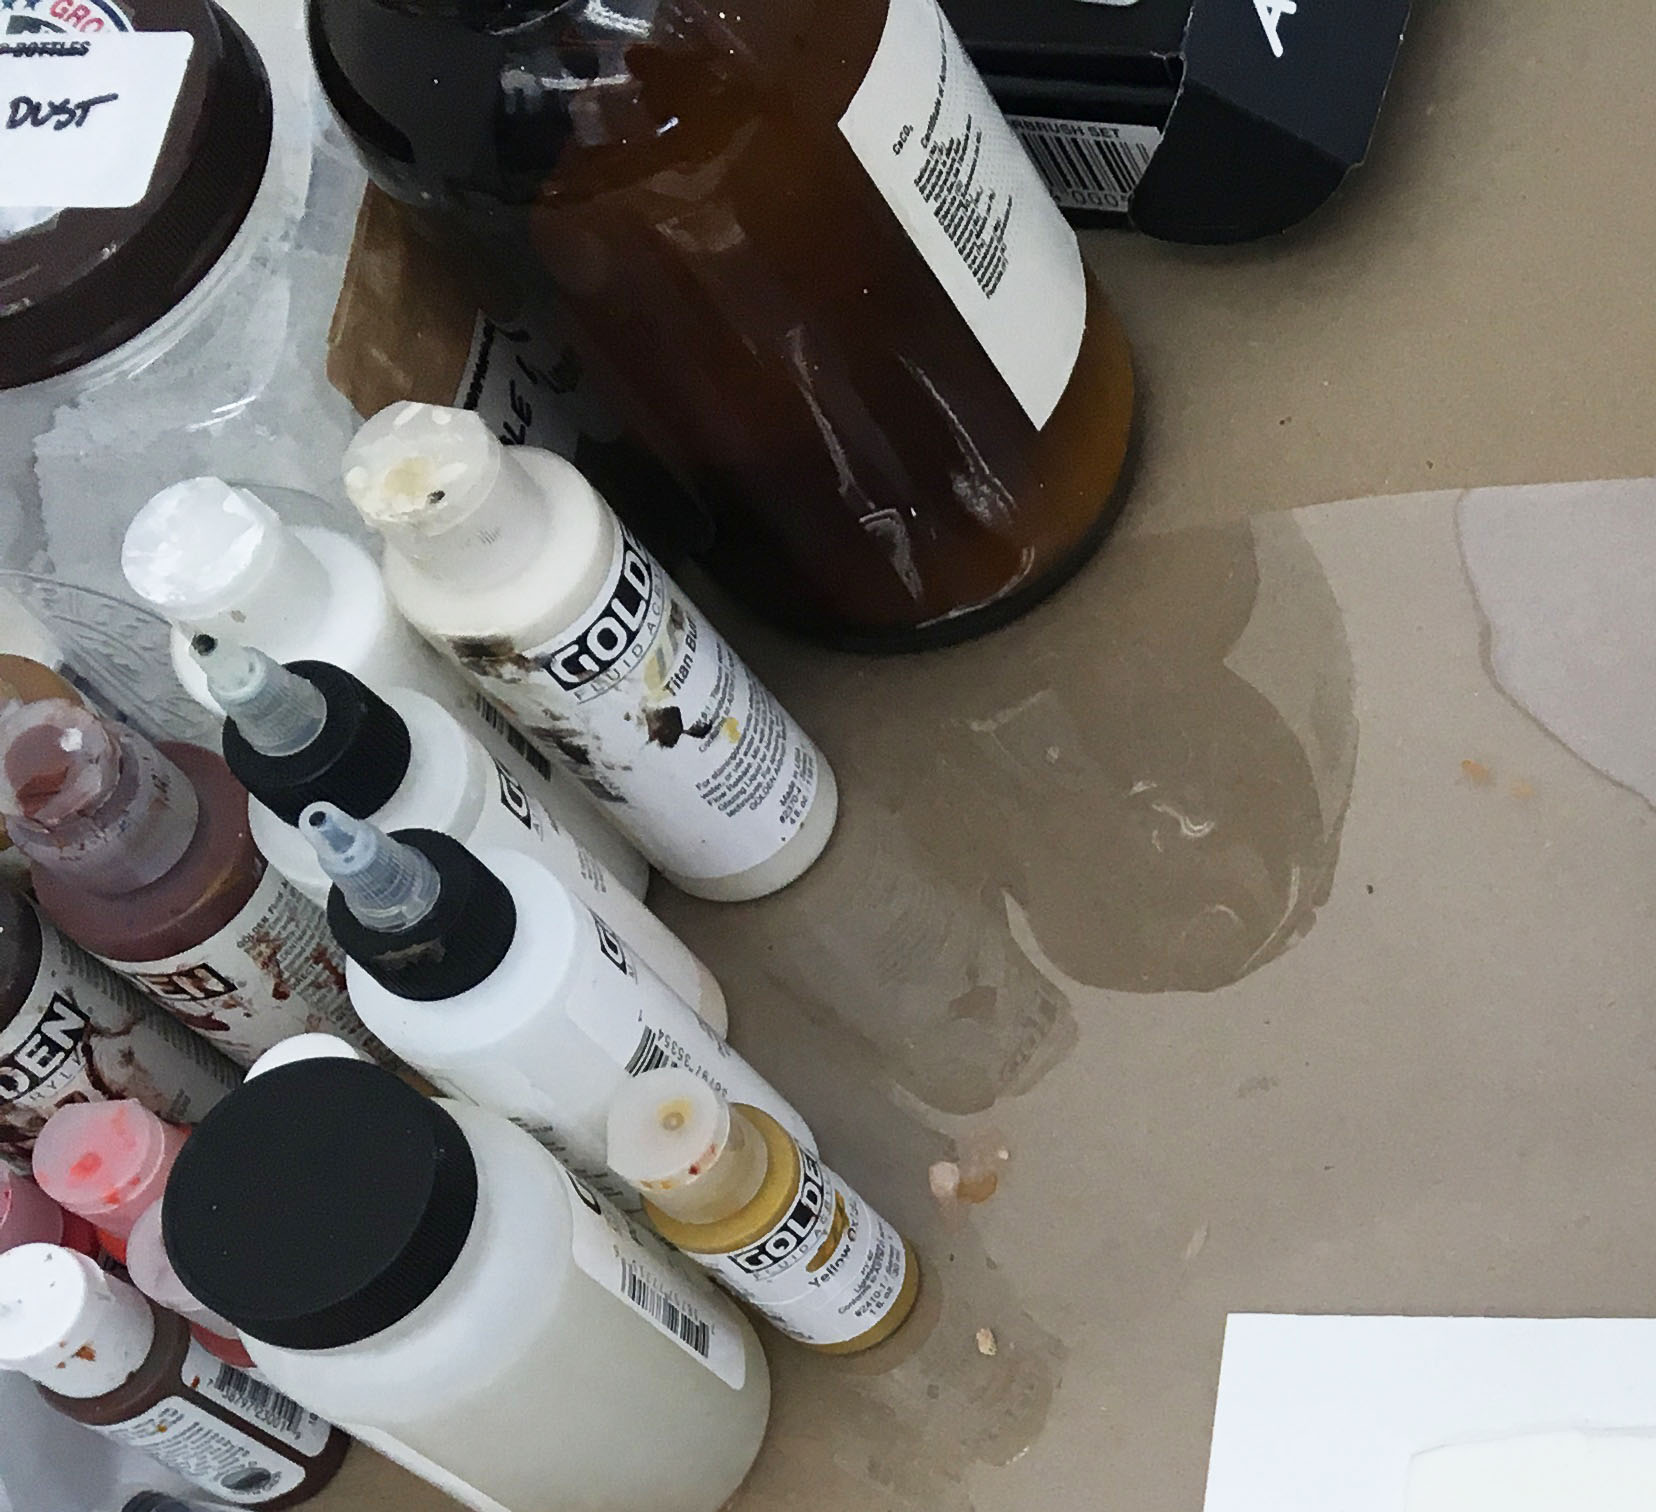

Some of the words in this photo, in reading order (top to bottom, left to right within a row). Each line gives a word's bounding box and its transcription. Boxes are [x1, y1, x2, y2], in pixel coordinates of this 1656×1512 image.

[6, 93, 118, 131] DUST
[1087, 125, 1120, 138] SET
[663, 653, 695, 697] Titan
[808, 1243, 852, 1289] Yellow
